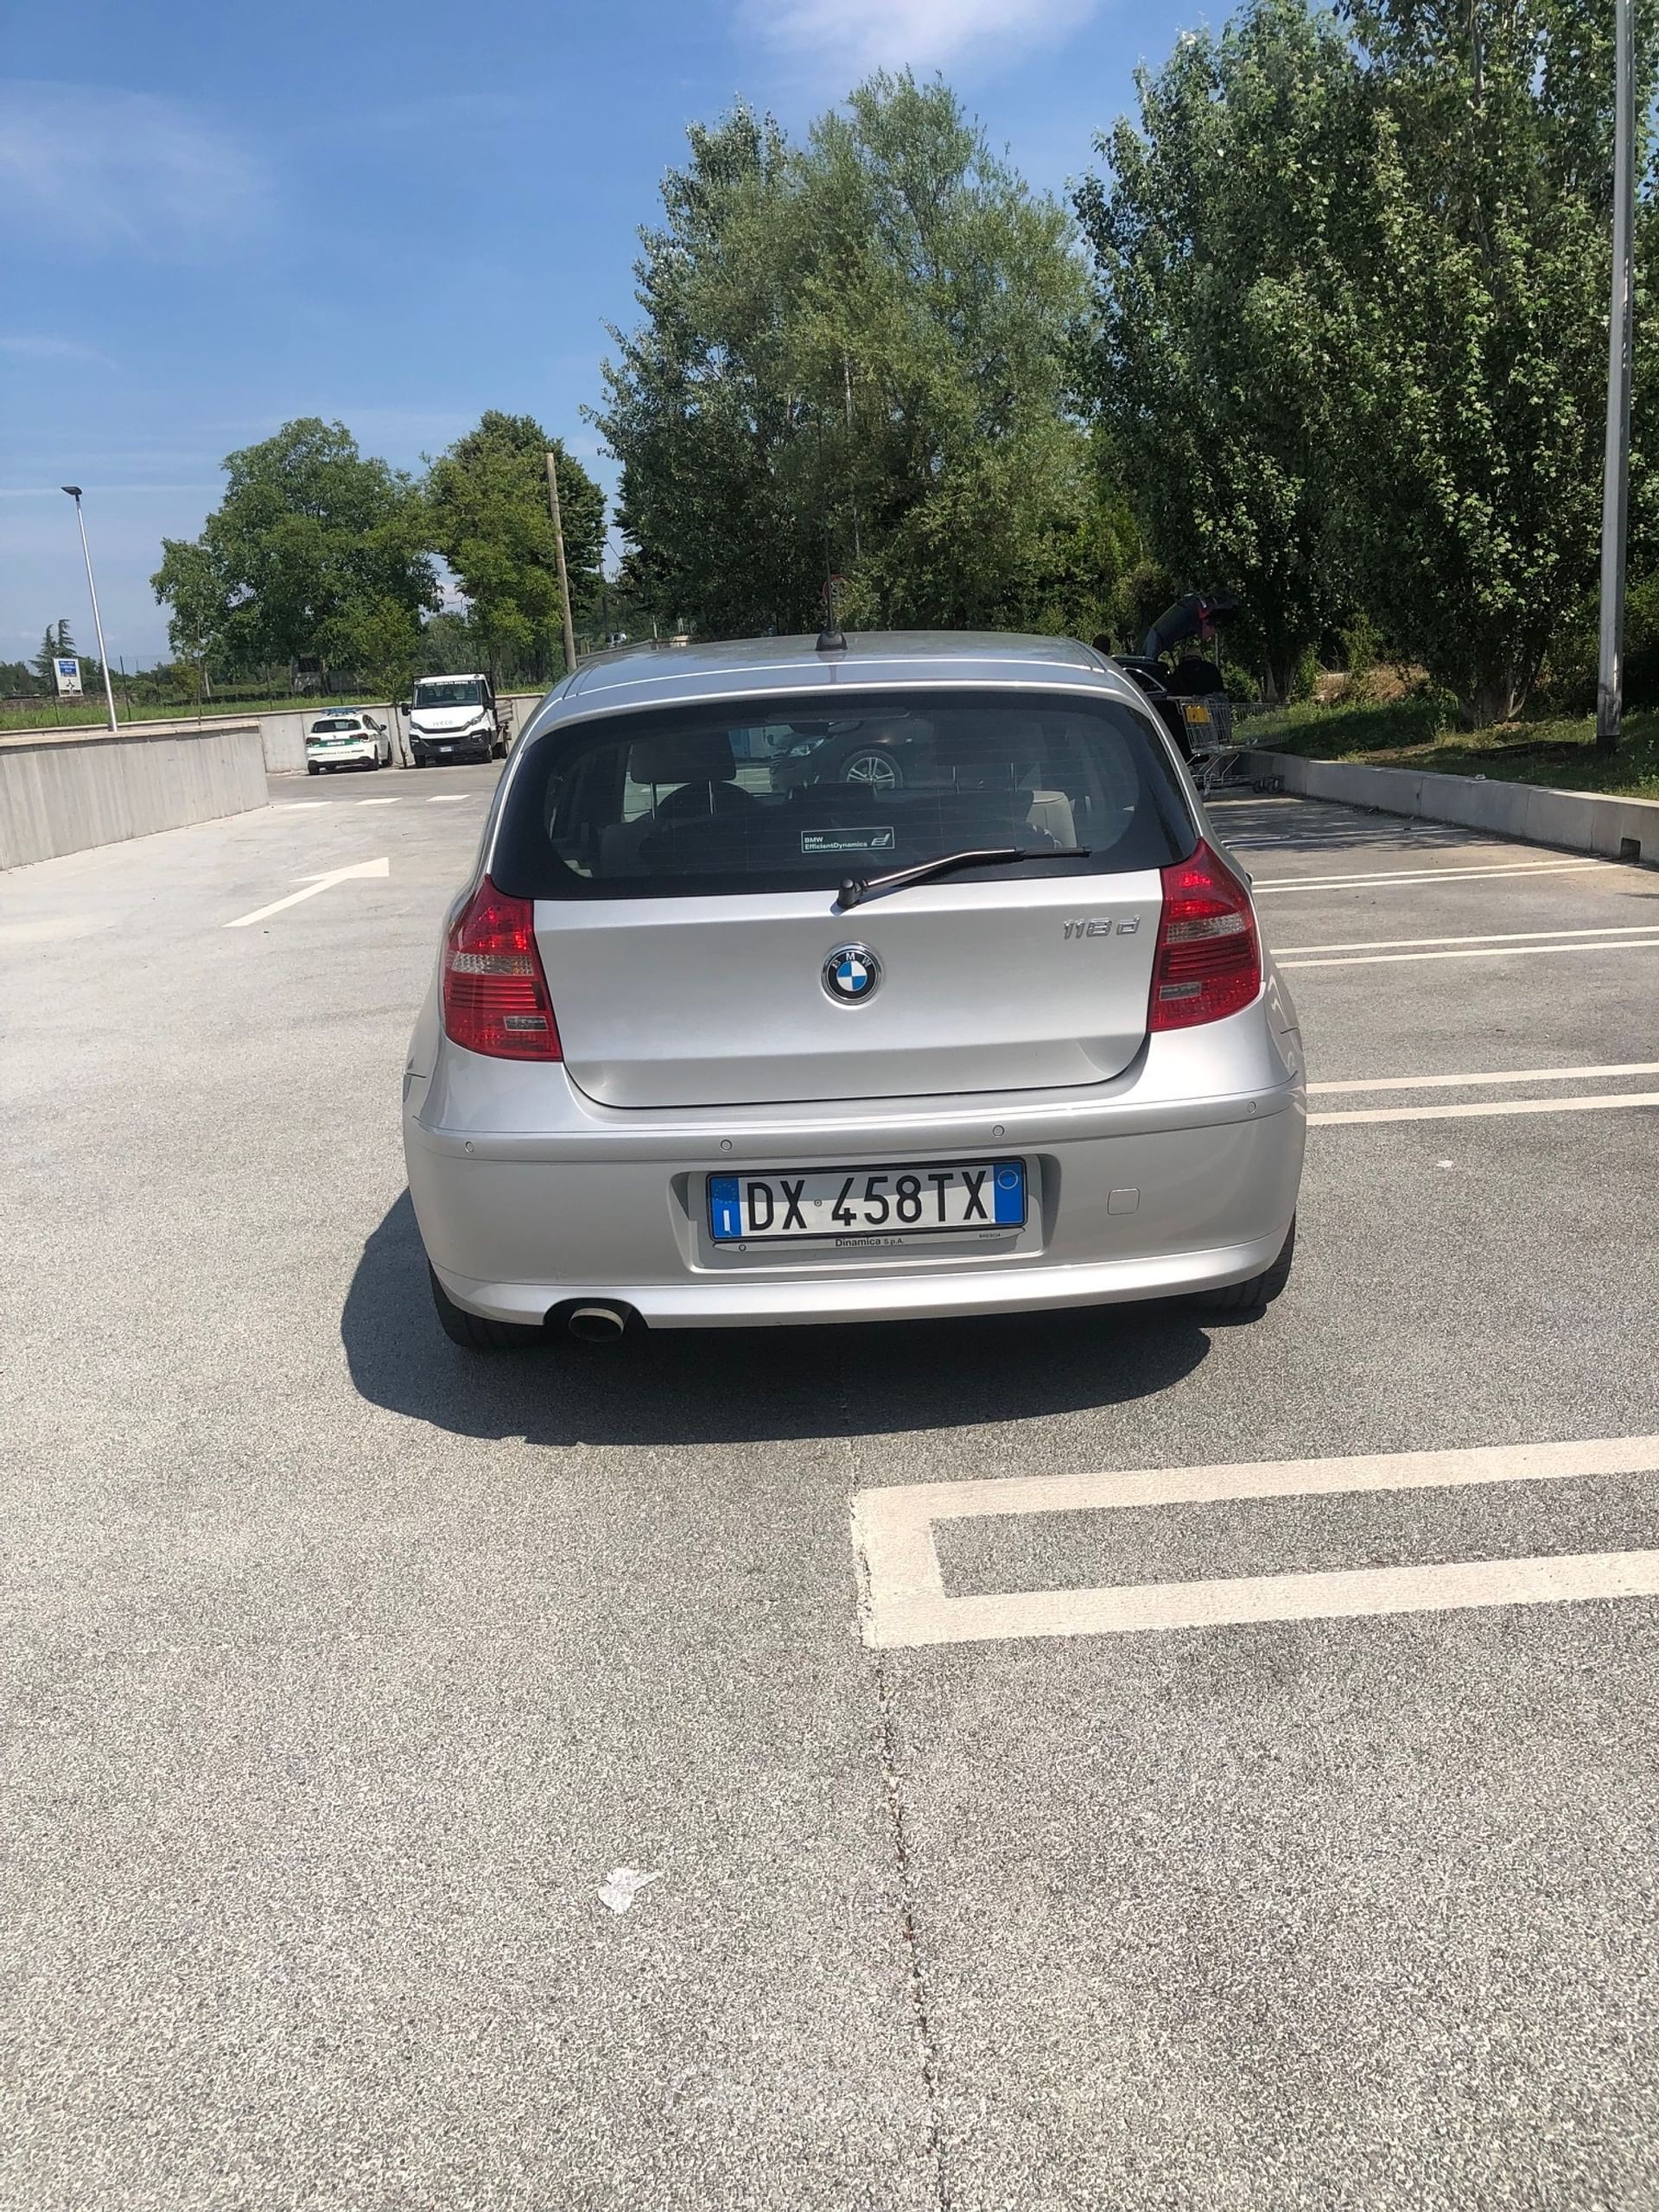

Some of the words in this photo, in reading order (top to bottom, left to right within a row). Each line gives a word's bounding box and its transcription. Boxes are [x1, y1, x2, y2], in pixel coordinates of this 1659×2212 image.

[804, 842, 868, 850] EfficientDynamics
[831, 952, 872, 969] BMW
[747, 1179, 807, 1230] DX
[831, 1171, 988, 1227] 458TX
[836, 1236, 881, 1247] Dinamica
